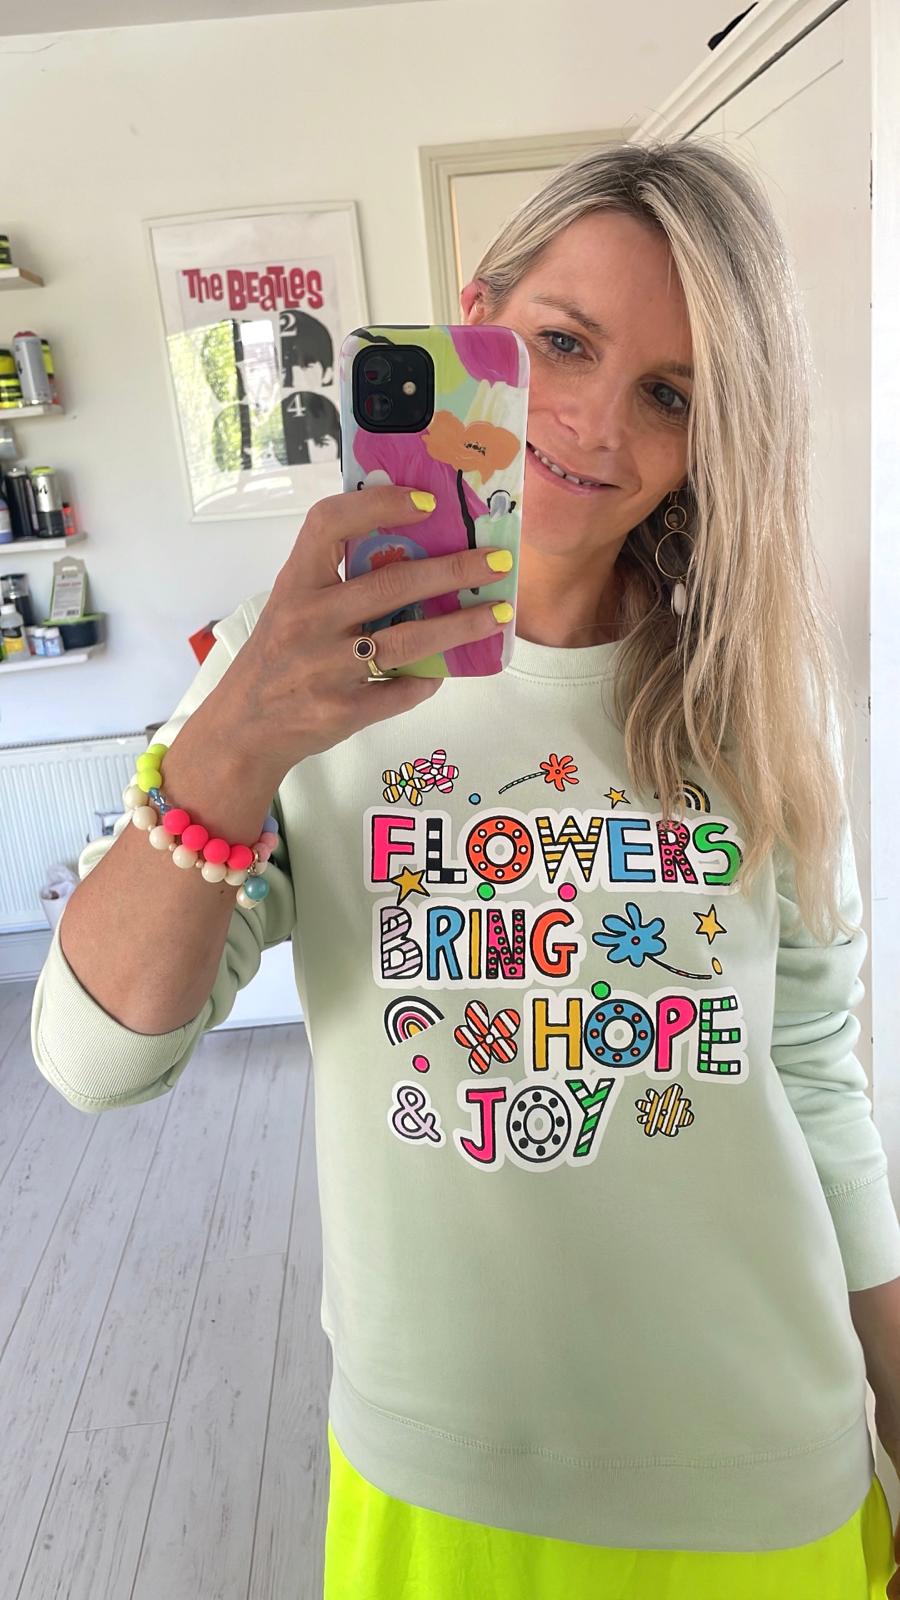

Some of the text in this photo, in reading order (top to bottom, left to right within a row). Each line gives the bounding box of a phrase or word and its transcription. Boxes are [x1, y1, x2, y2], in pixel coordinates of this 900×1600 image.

[182, 268, 223, 303] The
[280, 313, 298, 337] 2
[286, 394, 306, 418] 4
[371, 815, 743, 886] FLOWERS
[380, 906, 578, 981] BRING
[532, 995, 742, 1075] HOPE
[392, 1079, 615, 1163] & JOY
